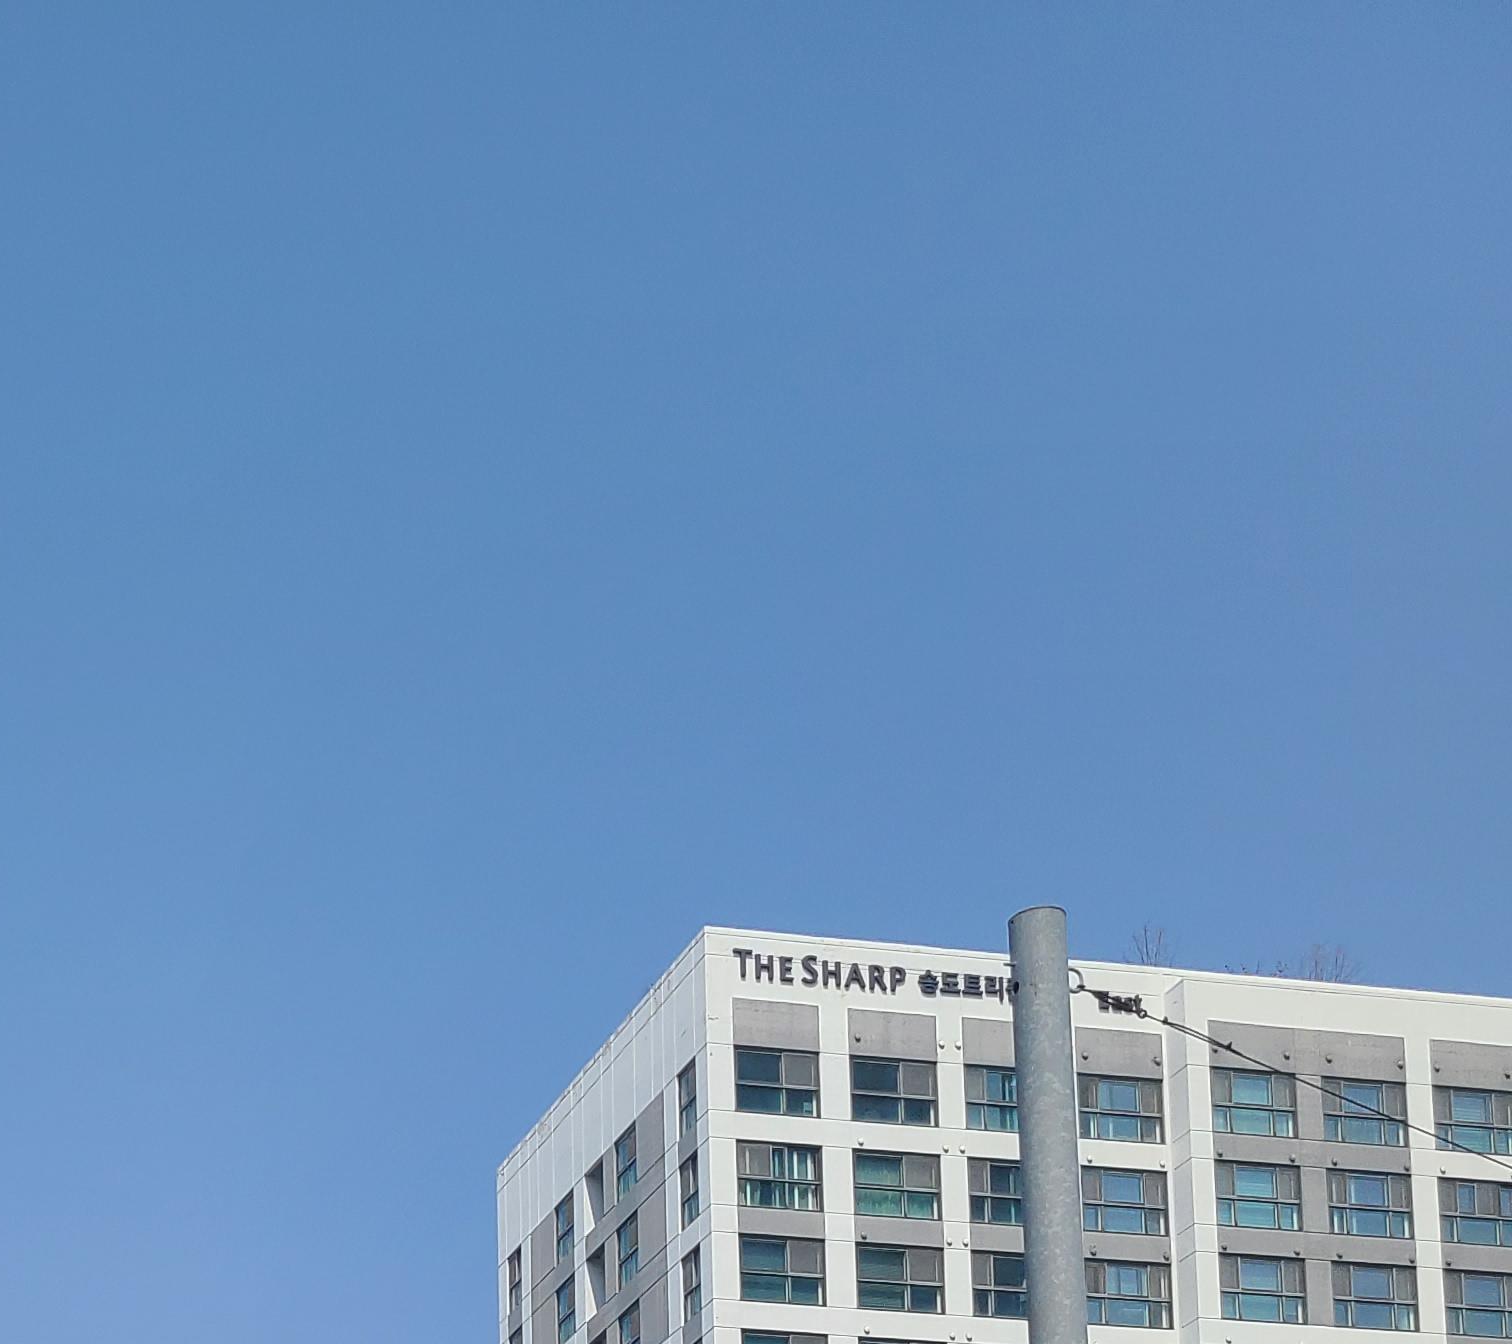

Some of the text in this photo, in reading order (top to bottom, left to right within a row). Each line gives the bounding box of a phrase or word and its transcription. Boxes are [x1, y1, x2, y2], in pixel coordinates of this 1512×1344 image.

[732, 947, 907, 994] THE SHARP
[918, 969, 1014, 1002] 송도트리
